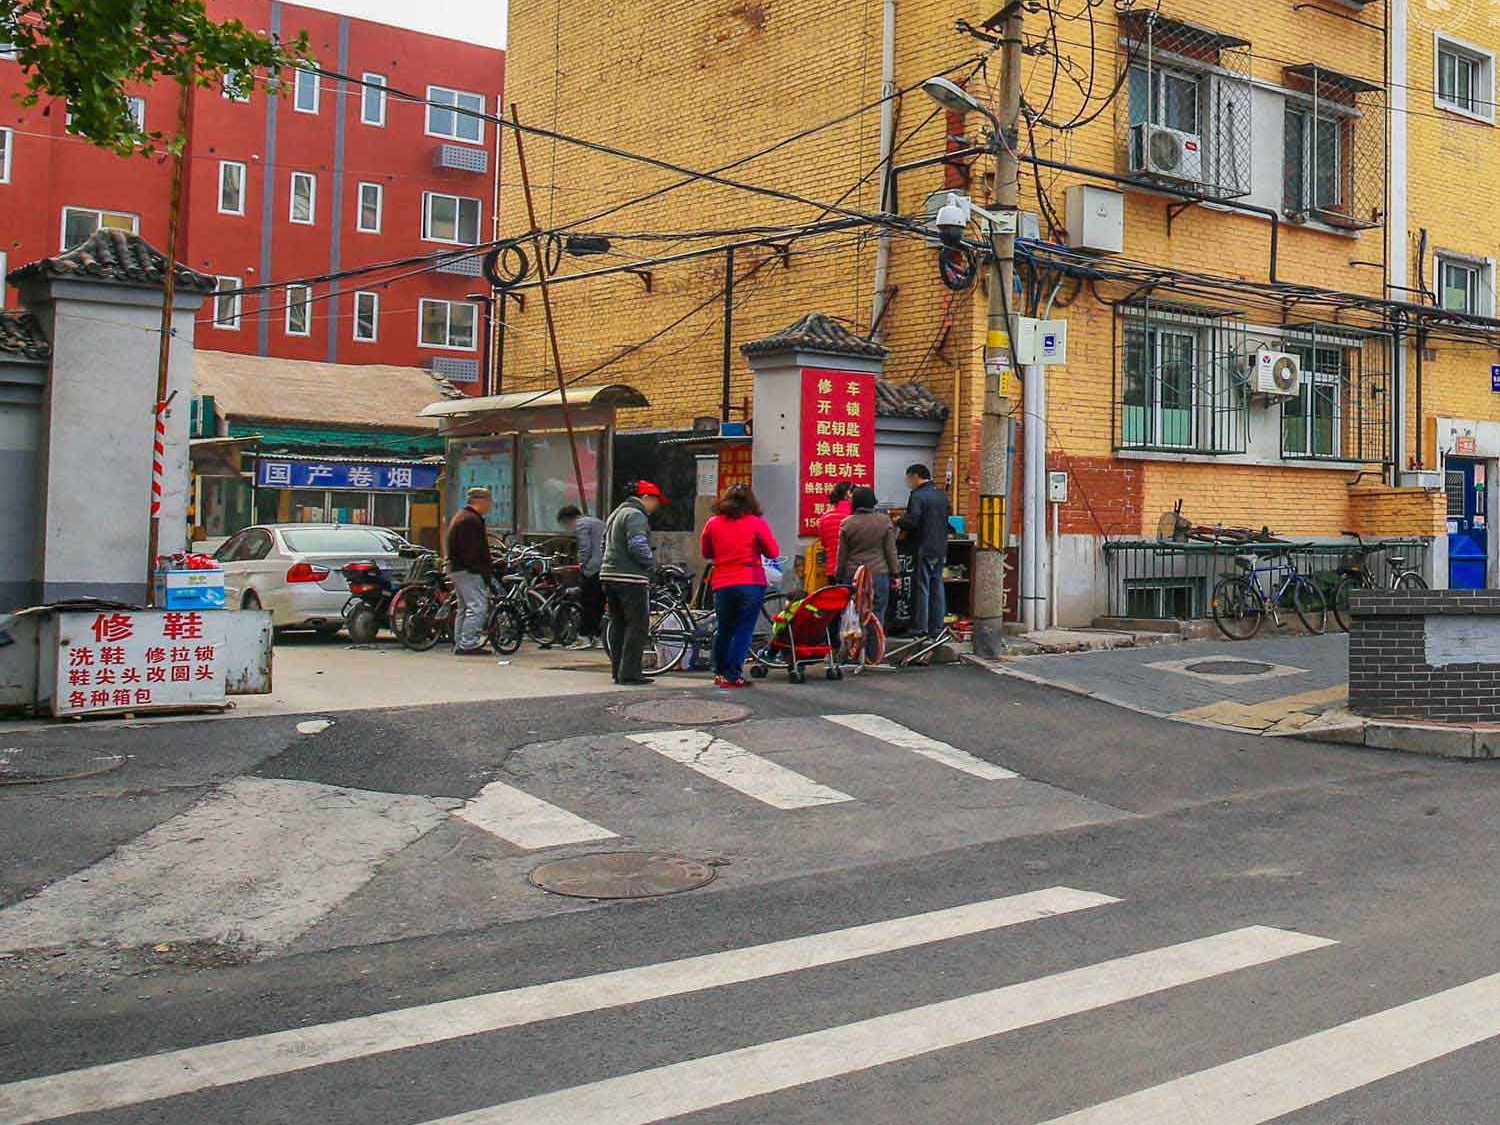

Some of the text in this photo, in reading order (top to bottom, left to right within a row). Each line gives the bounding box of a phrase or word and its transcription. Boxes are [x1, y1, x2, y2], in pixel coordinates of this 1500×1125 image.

[817, 378, 861, 395] 修车
[817, 400, 861, 416] 开锁
[816, 420, 861, 437] 配钥匙
[816, 441, 860, 457] 换电瓶
[265, 463, 412, 487] 国产卷烟
[809, 461, 867, 478] 修电动车
[91, 612, 203, 643] 修鞋
[69, 645, 214, 666] 洗鞋 修拉锁
[68, 665, 214, 687] 鞋尖头改圆头
[68, 688, 152, 708] 各种箱包
